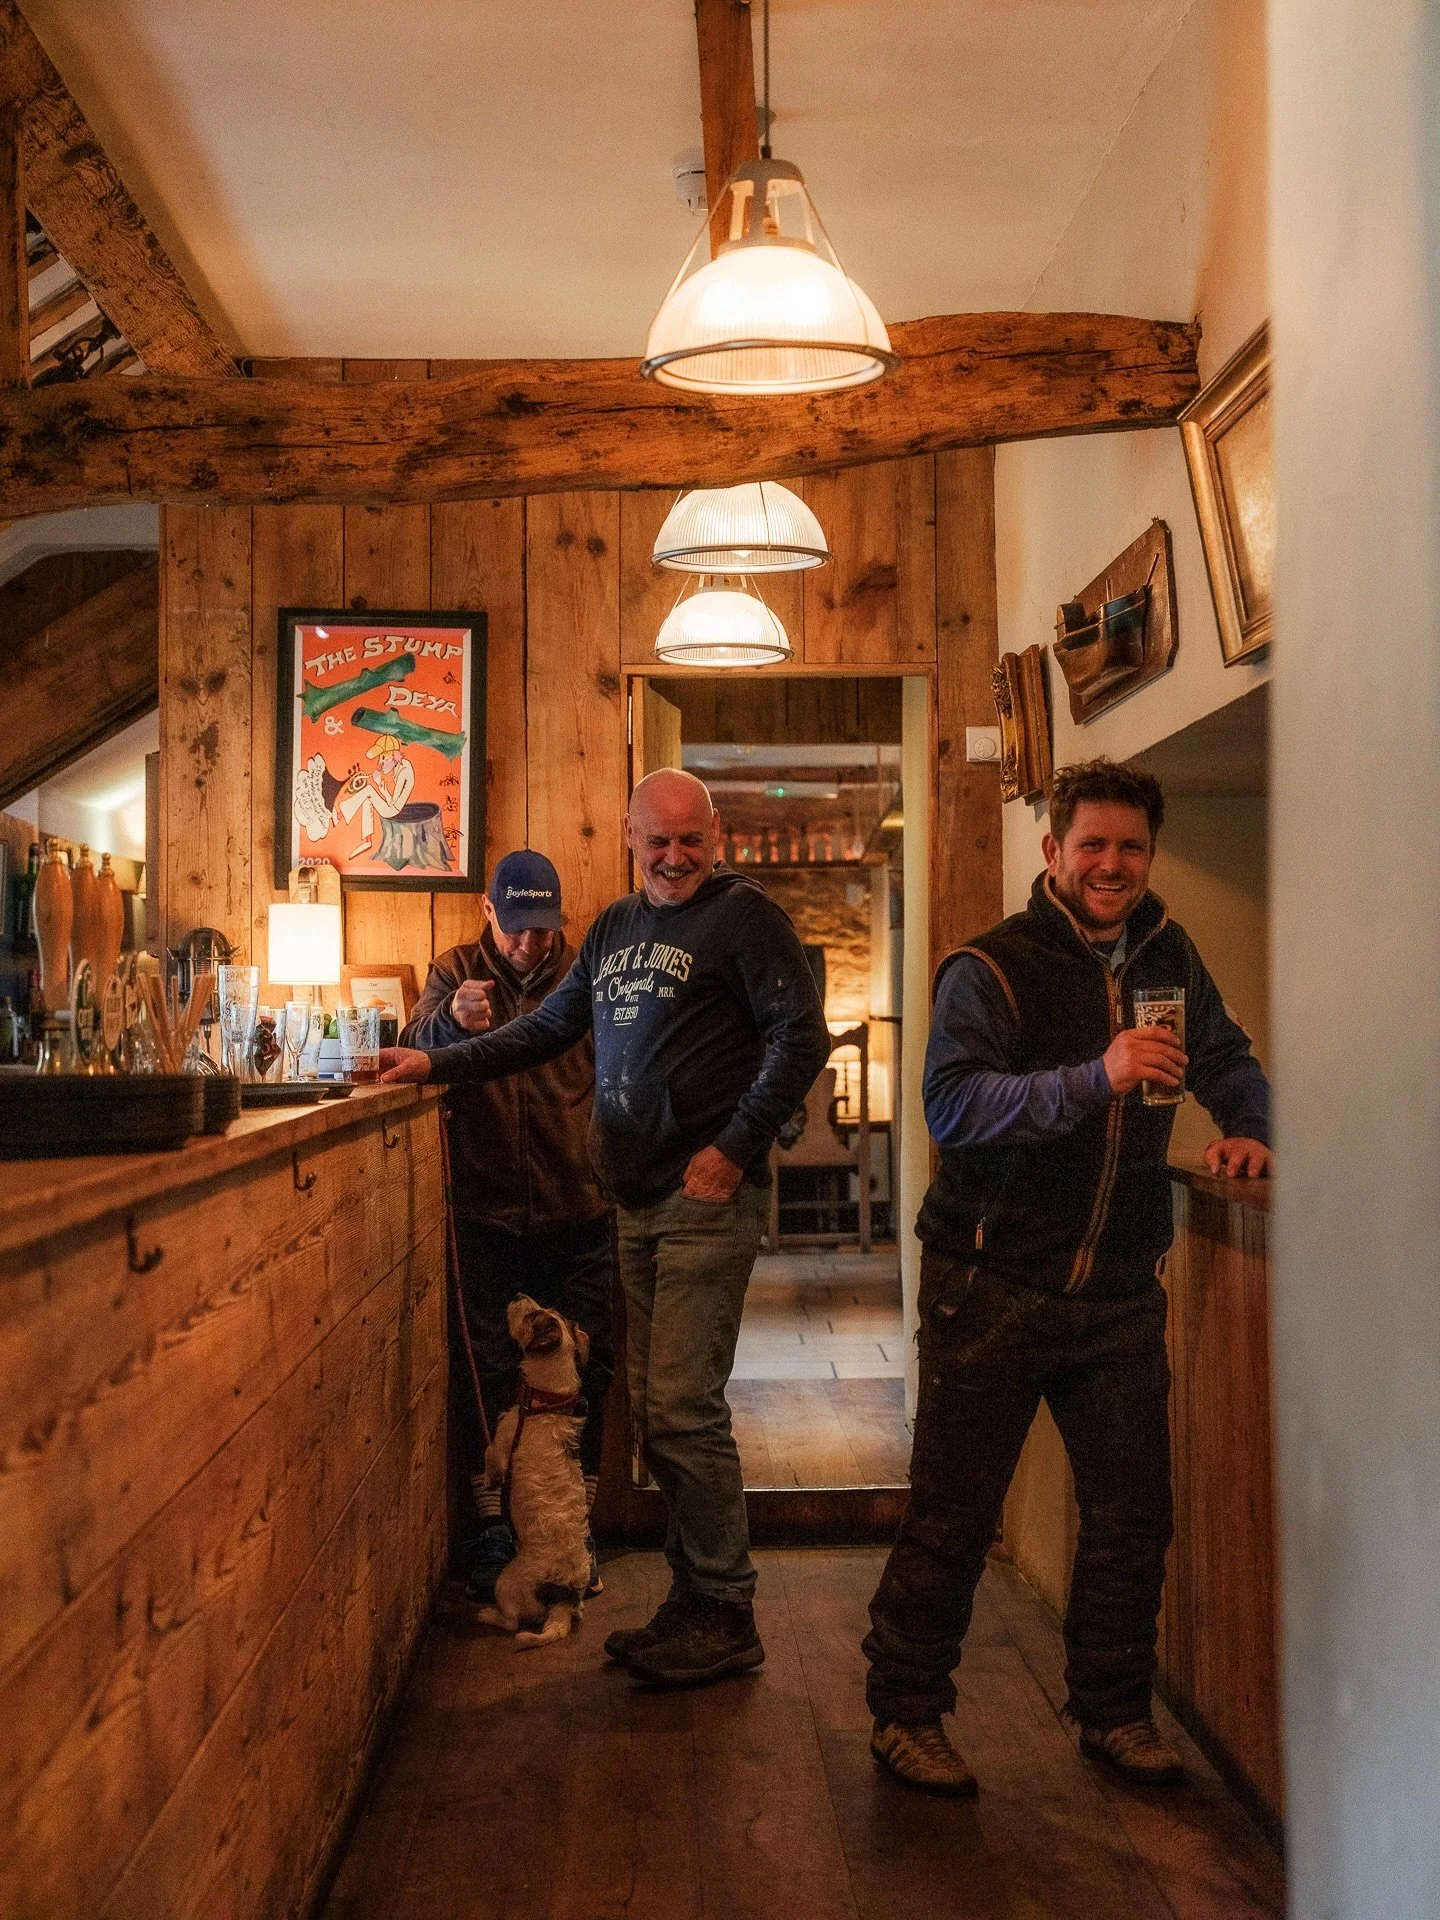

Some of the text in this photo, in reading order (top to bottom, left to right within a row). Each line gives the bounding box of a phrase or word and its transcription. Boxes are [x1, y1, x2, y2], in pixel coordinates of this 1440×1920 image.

[304, 635, 464, 678] THE STUMP
[384, 685, 460, 718] DEYA
[323, 715, 345, 736] &
[298, 857, 331, 866] 2020
[505, 885, 553, 899] BoyleSports
[592, 942, 693, 986] JACK & JONES
[608, 971, 655, 1002] Originals
